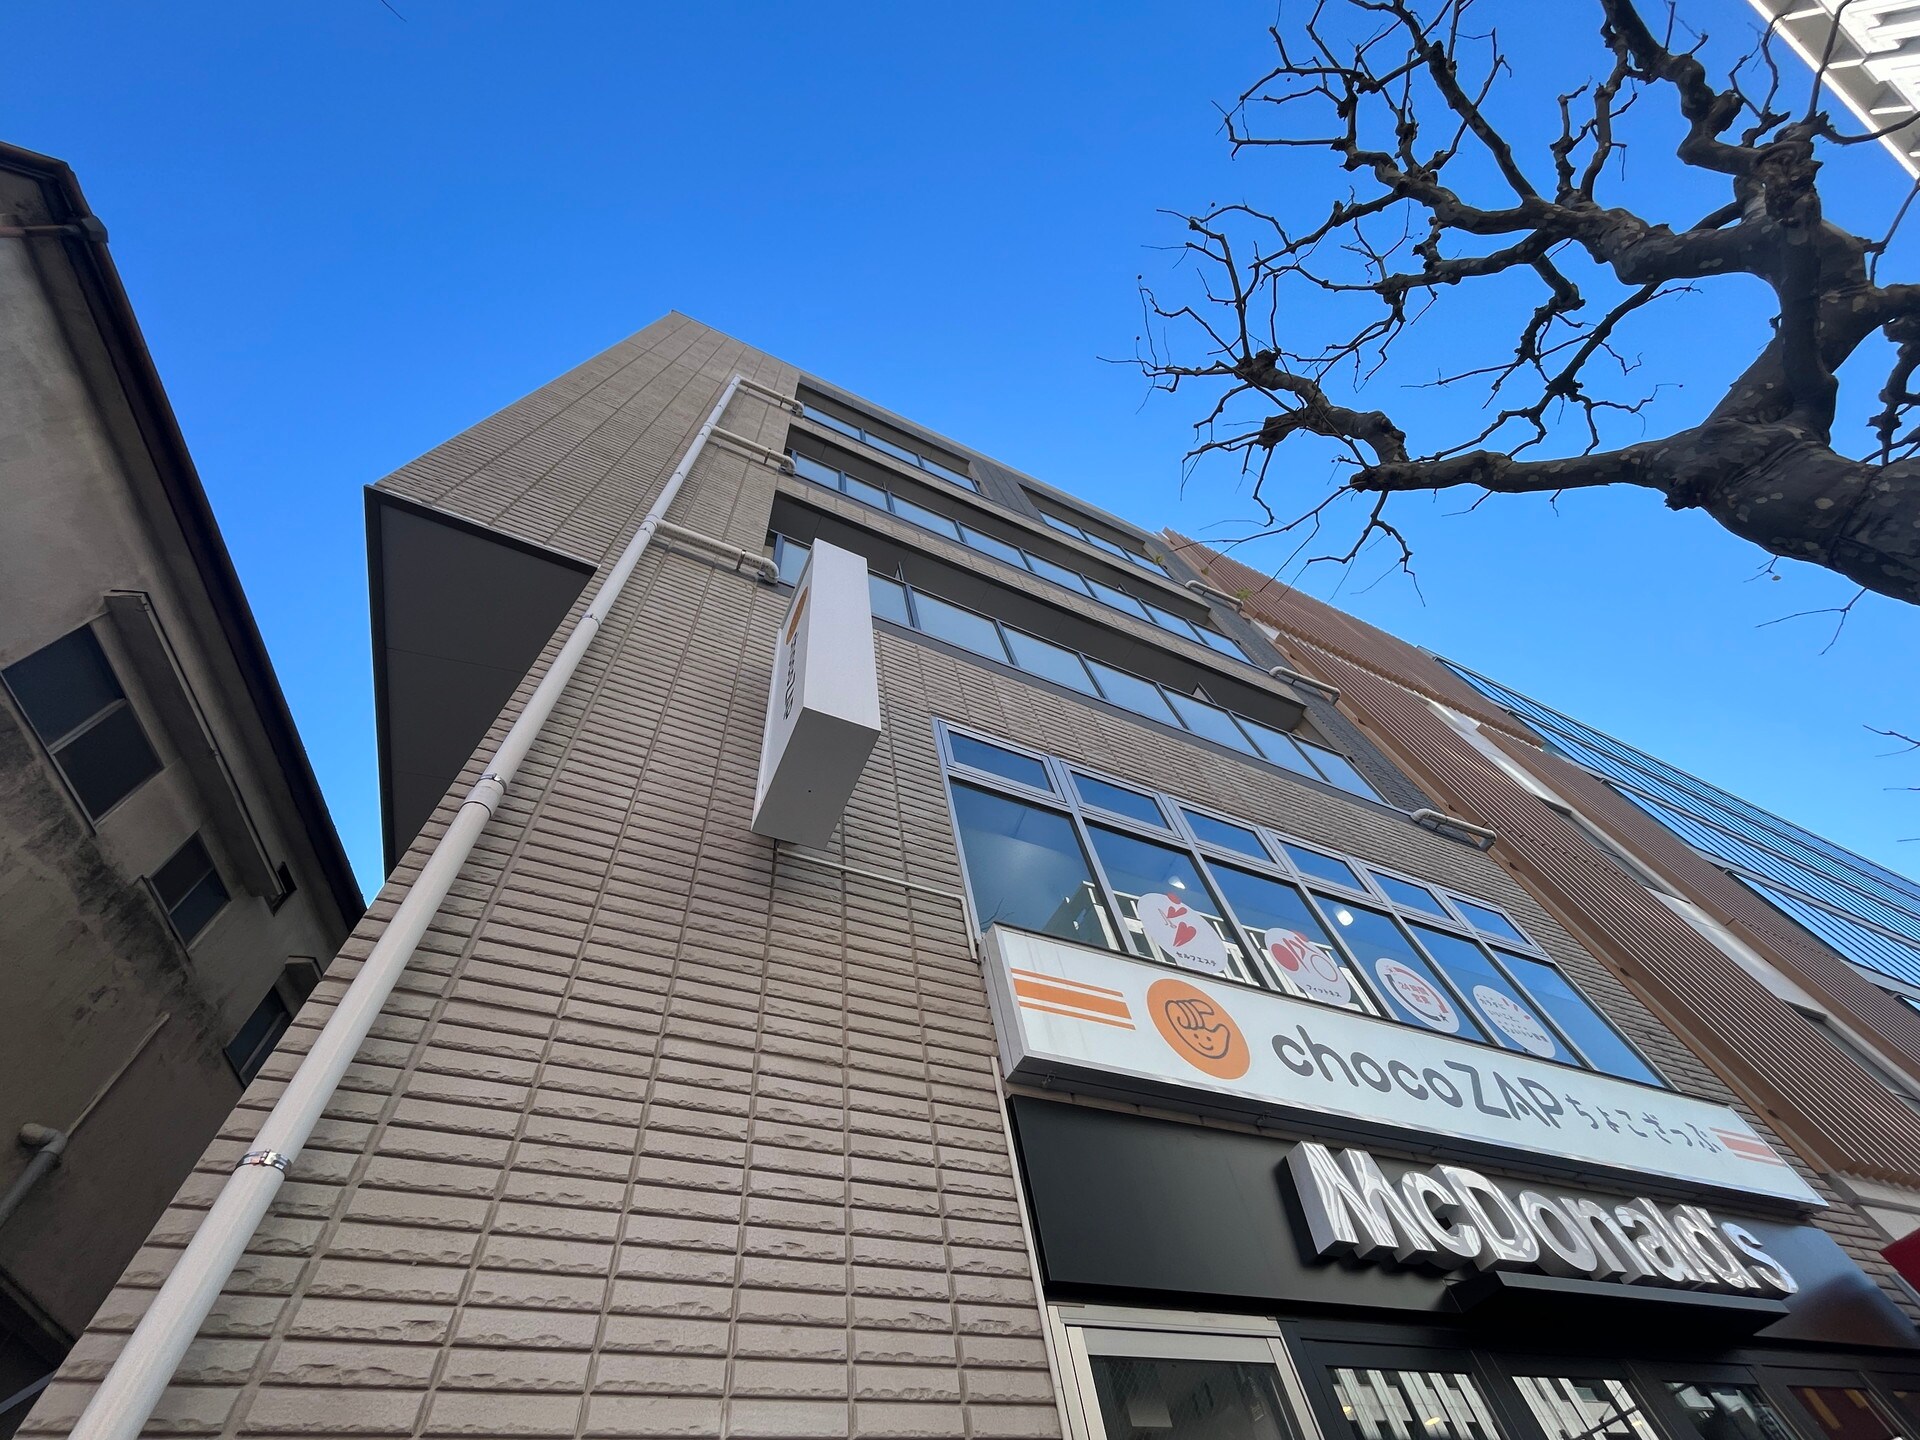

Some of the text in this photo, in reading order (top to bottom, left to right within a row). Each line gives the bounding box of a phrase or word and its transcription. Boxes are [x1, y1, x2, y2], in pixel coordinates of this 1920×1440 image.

[1271, 1024, 1722, 1154] chocoZAP ちょこざっぷ
[1287, 1140, 1799, 1296] McDonald's
